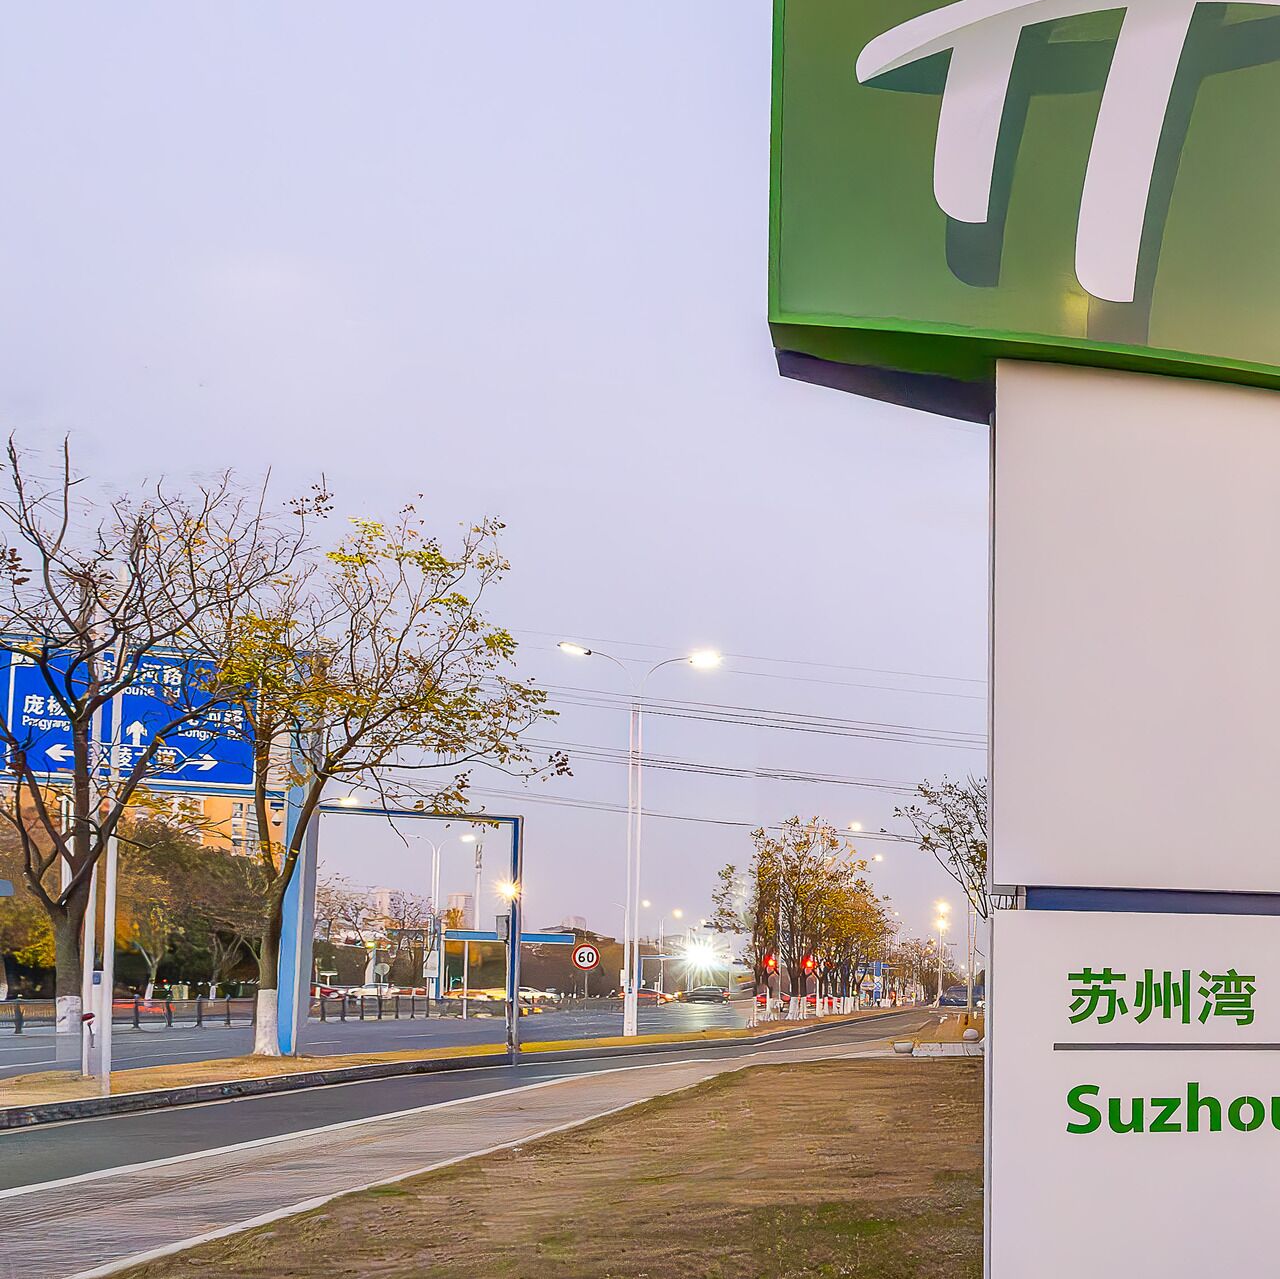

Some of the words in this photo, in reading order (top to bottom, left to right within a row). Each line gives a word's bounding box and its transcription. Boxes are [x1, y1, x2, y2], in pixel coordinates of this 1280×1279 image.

[578, 951, 595, 963] 60
[1066, 966, 1258, 1027] 苏州湾
